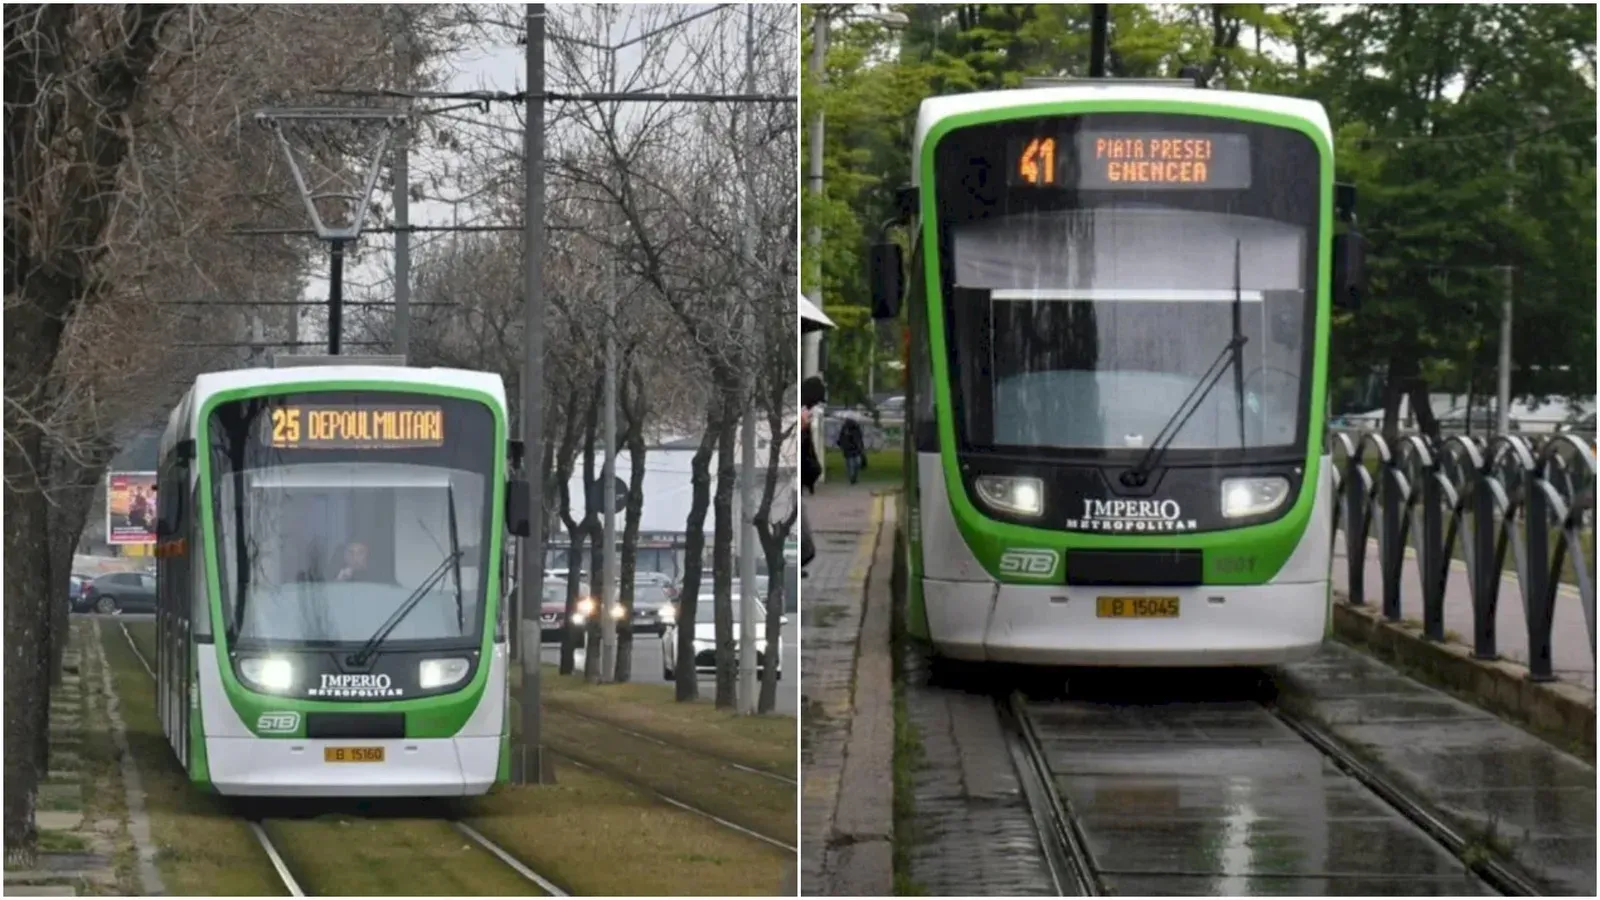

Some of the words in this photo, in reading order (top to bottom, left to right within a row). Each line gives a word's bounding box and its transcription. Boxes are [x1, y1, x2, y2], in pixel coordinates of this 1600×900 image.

[1150, 139, 1211, 158] PRESEI
[1020, 137, 1055, 184] 41
[1107, 162, 1207, 182] GHENCEA
[272, 409, 300, 441] 25
[308, 410, 372, 440] DEPOUL
[373, 410, 443, 440] MILITARI
[1083, 499, 1180, 520] IMPERIO
[1066, 519, 1197, 531] METROPOLITAN
[1000, 552, 1052, 572] STB
[1112, 598, 1125, 616] B
[1132, 598, 1179, 616] 15045
[320, 674, 391, 689] IMPERIO
[308, 688, 403, 696] METROPOLITAN
[257, 714, 299, 729] STB
[336, 748, 345, 760] B
